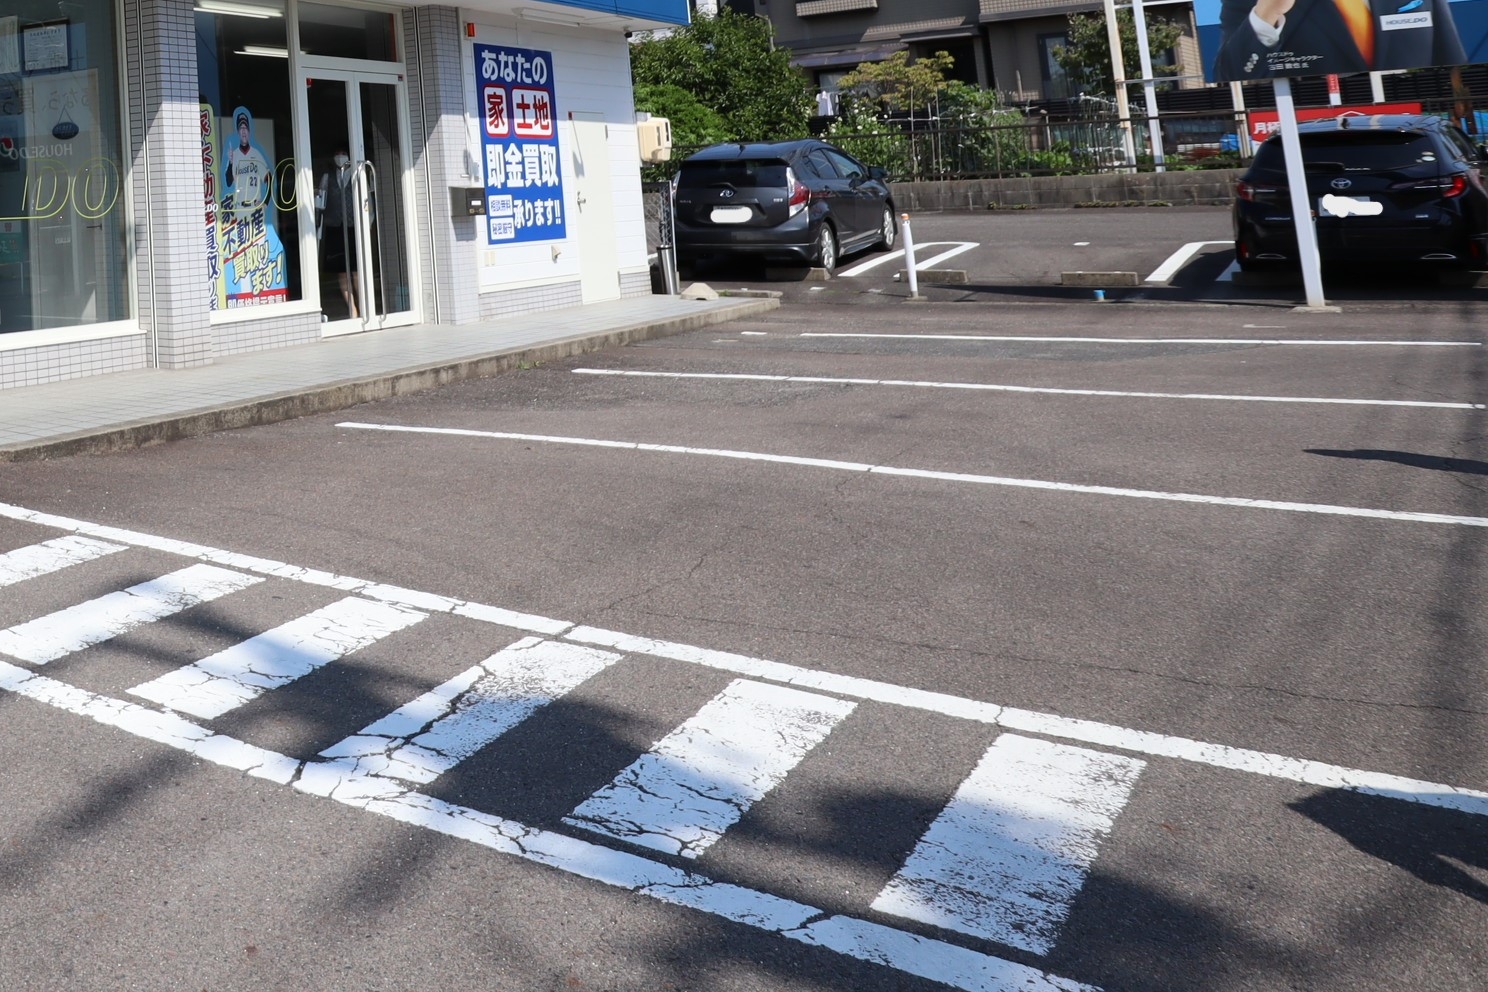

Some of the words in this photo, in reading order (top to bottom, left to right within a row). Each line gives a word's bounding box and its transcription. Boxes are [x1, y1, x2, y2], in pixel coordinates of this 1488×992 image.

[481, 49, 547, 85] あなたの
[487, 92, 505, 129] 家
[516, 93, 550, 130] 土地
[485, 143, 559, 189] 即金買取
[223, 209, 265, 255] 不動産
[233, 240, 269, 285] 買取り
